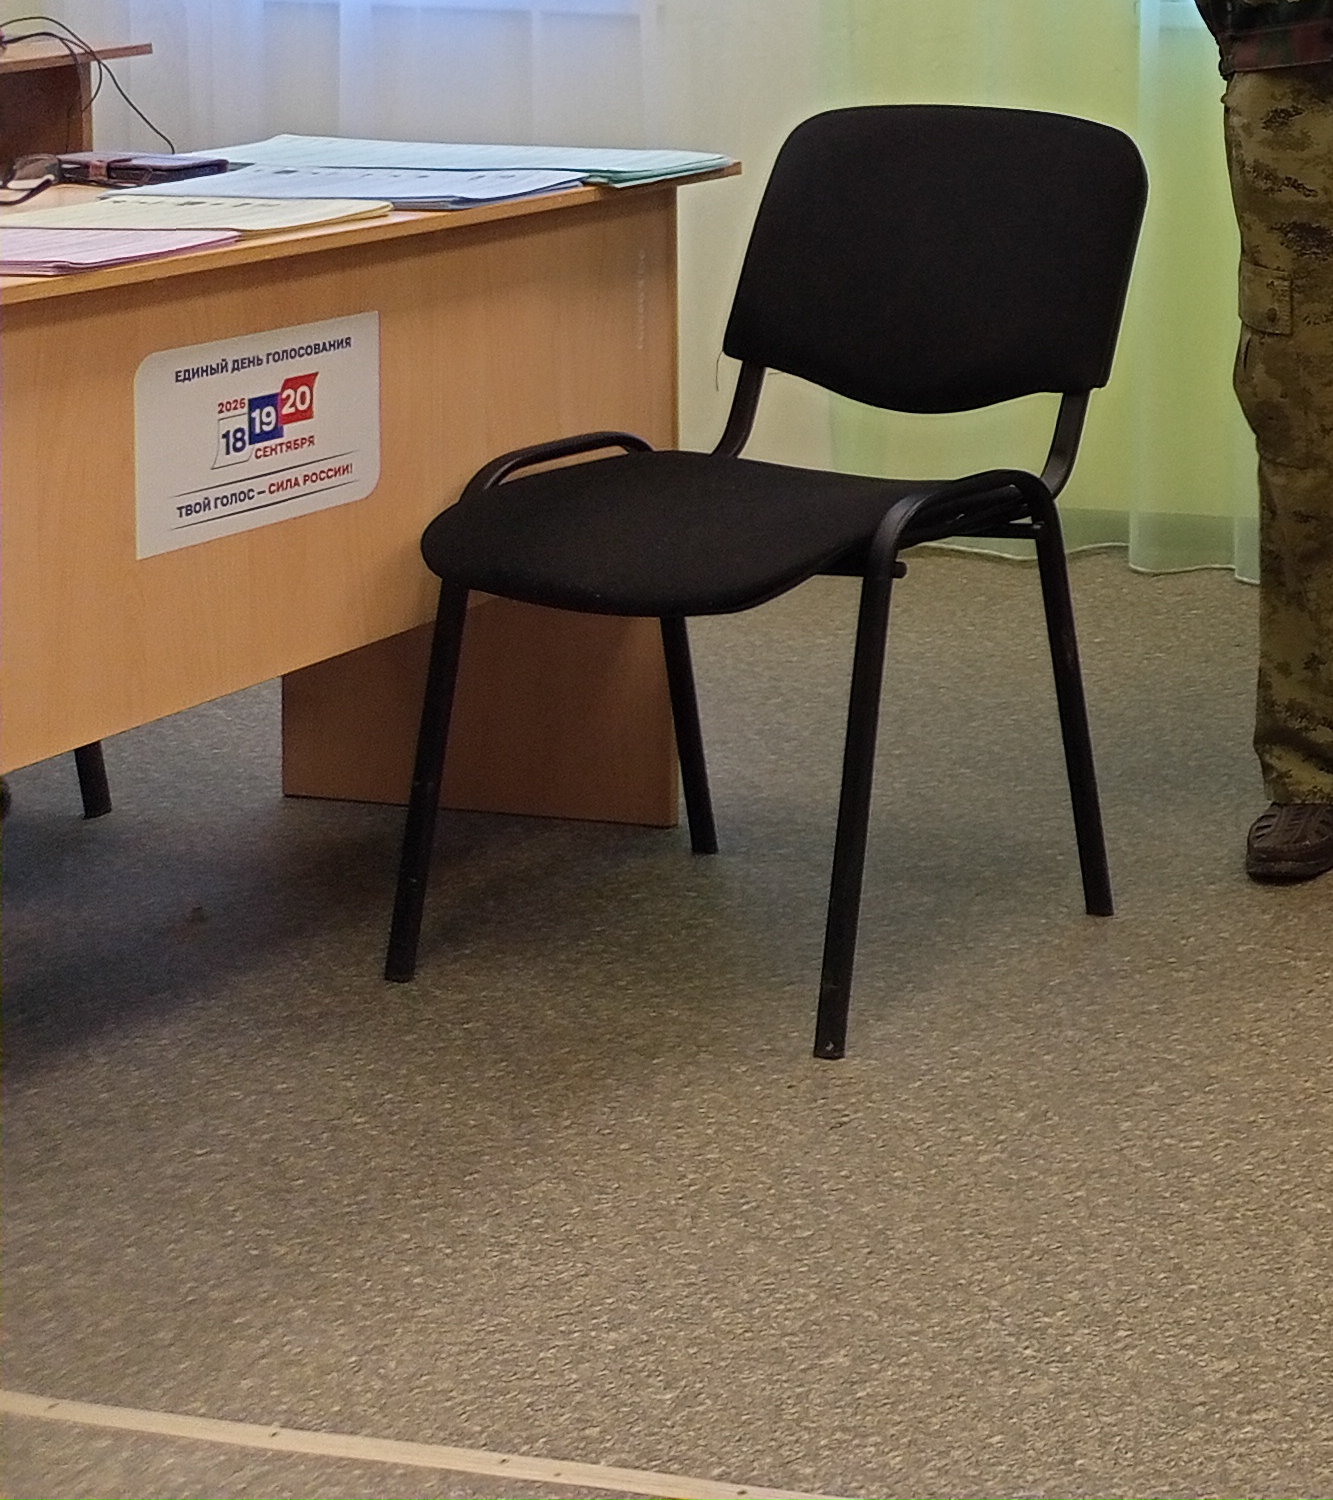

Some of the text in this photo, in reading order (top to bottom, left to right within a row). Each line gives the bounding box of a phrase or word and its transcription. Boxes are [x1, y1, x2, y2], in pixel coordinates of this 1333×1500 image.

[175, 336, 352, 382] ЕДИНЫЙ ДЕНЬ ГОЛОСОВАНИЯ
[217, 398, 247, 414] 2026
[221, 385, 311, 455] 18 19 20
[254, 435, 315, 460] СЕНТЯБРЯ
[176, 497, 212, 518] ТВОЙ
[214, 488, 255, 509] ГОЛОС
[268, 476, 300, 495] СИЛА
[303, 463, 353, 486] РОССИИ!
